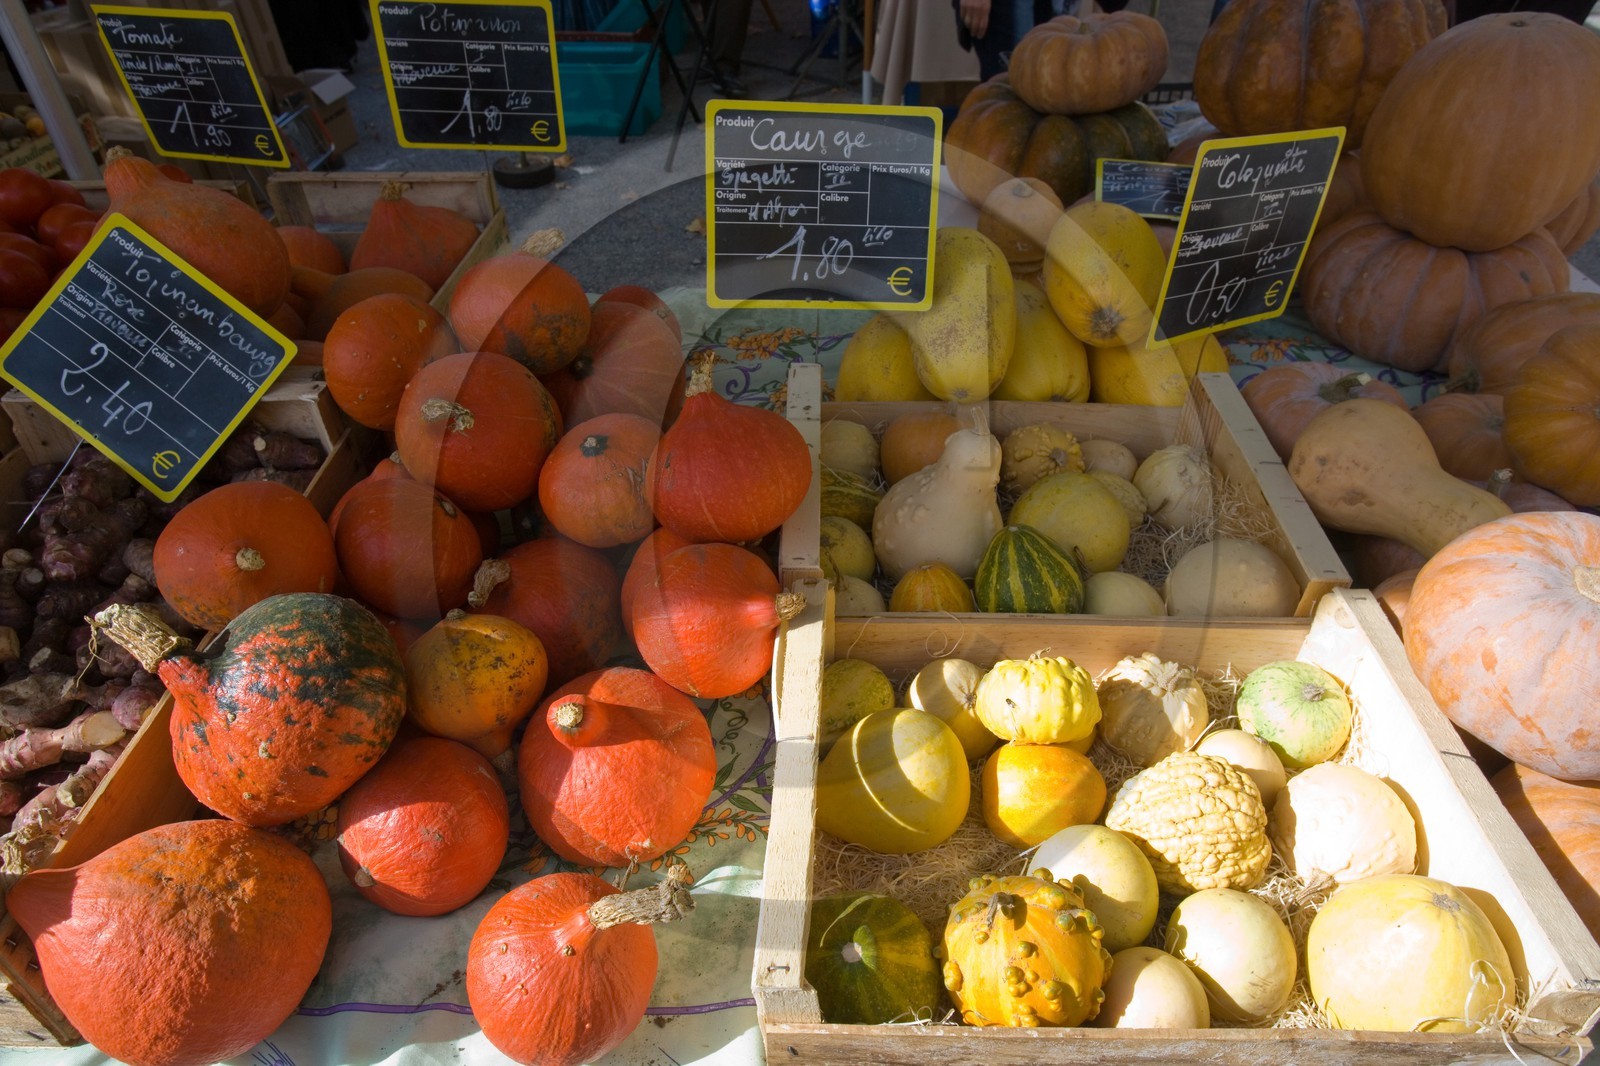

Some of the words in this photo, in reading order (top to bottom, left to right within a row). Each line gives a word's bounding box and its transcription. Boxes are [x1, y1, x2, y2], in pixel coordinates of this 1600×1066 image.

[379, 6, 409, 16] Produit
[98, 18, 122, 27] Produit
[112, 23, 183, 46] Tomate
[465, 43, 495, 51] Catégorie
[716, 116, 755, 127] Produit
[716, 160, 745, 169] Variété
[821, 163, 860, 173] Catégorie
[889, 166, 915, 174] Euros/1
[918, 167, 930, 176] Kg
[716, 191, 746, 201] Origine
[820, 194, 849, 202] Calibre
[1260, 192, 1285, 202] Catégorie
[1191, 202, 1212, 211] Variété
[1251, 223, 1269, 232] Calibre
[109, 230, 145, 259] Produit
[86, 261, 112, 284] Variété
[887, 266, 913, 296] €
[66, 285, 94, 307] Origine
[58, 296, 86, 319] Traitement
[170, 324, 203, 352] Catégorie
[150, 347, 176, 369] Calibre
[210, 355, 224, 368] Prix
[222, 361, 247, 386] Euros/1
[245, 381, 255, 393] Kg
[152, 450, 182, 479] €
